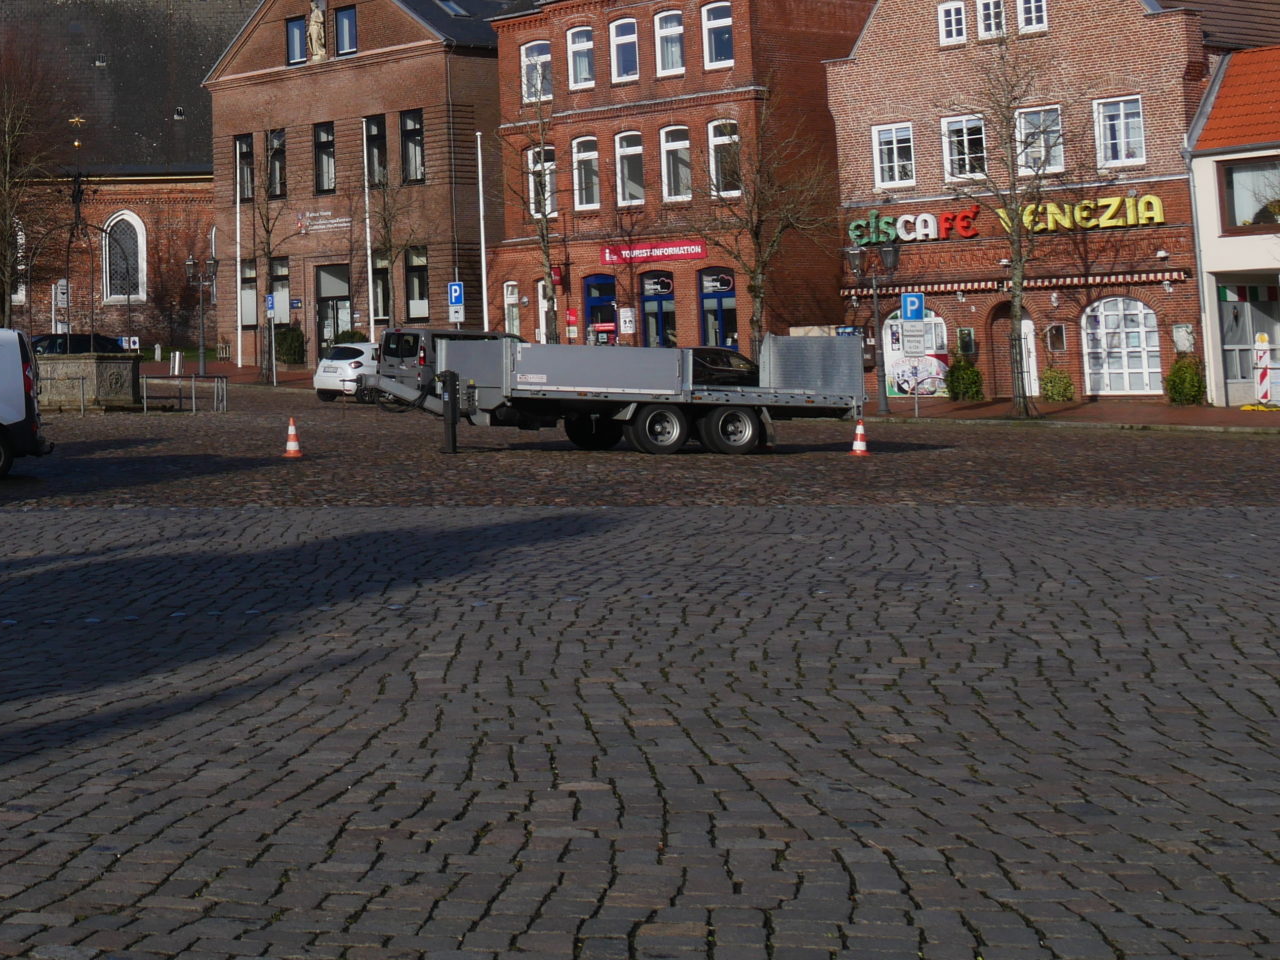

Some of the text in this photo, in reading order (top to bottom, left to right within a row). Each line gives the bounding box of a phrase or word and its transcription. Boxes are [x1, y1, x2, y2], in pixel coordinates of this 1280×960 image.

[995, 194, 1165, 234] VENEZIA
[620, 245, 702, 258] TOURIST-INFORMATION
[451, 285, 460, 303] P
[907, 297, 919, 318] P
